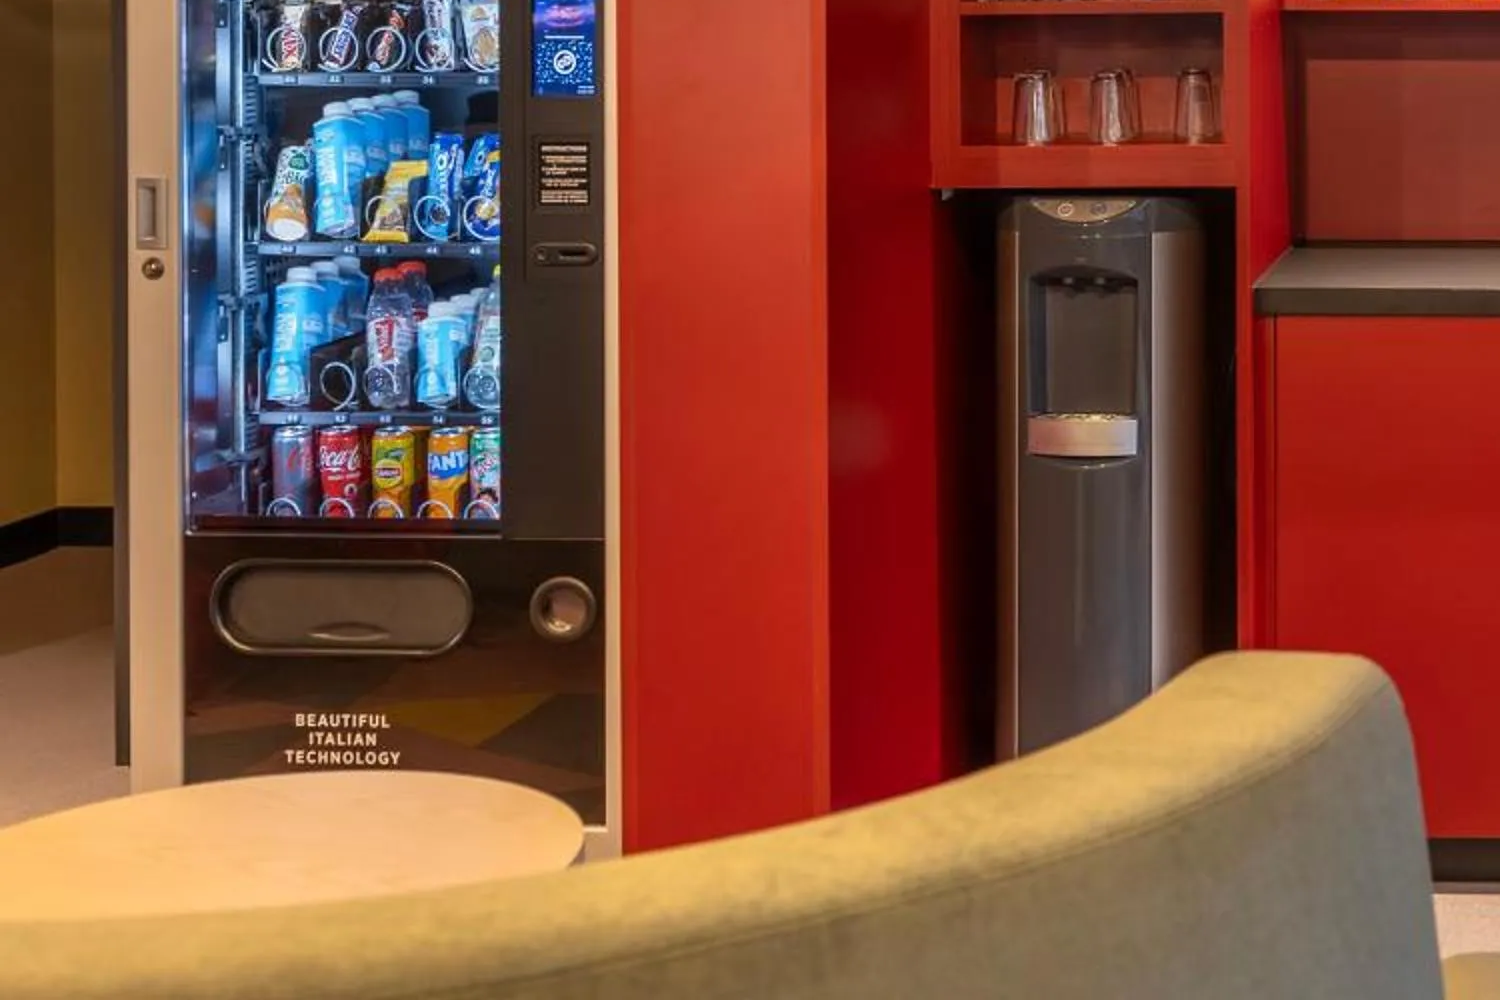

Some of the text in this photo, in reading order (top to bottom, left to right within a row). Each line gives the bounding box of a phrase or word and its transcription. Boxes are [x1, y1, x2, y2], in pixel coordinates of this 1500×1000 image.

[295, 713, 390, 728] BEAUTIFUL
[309, 732, 377, 746] ITALIAN
[285, 750, 401, 765] TECHNOLOGY
